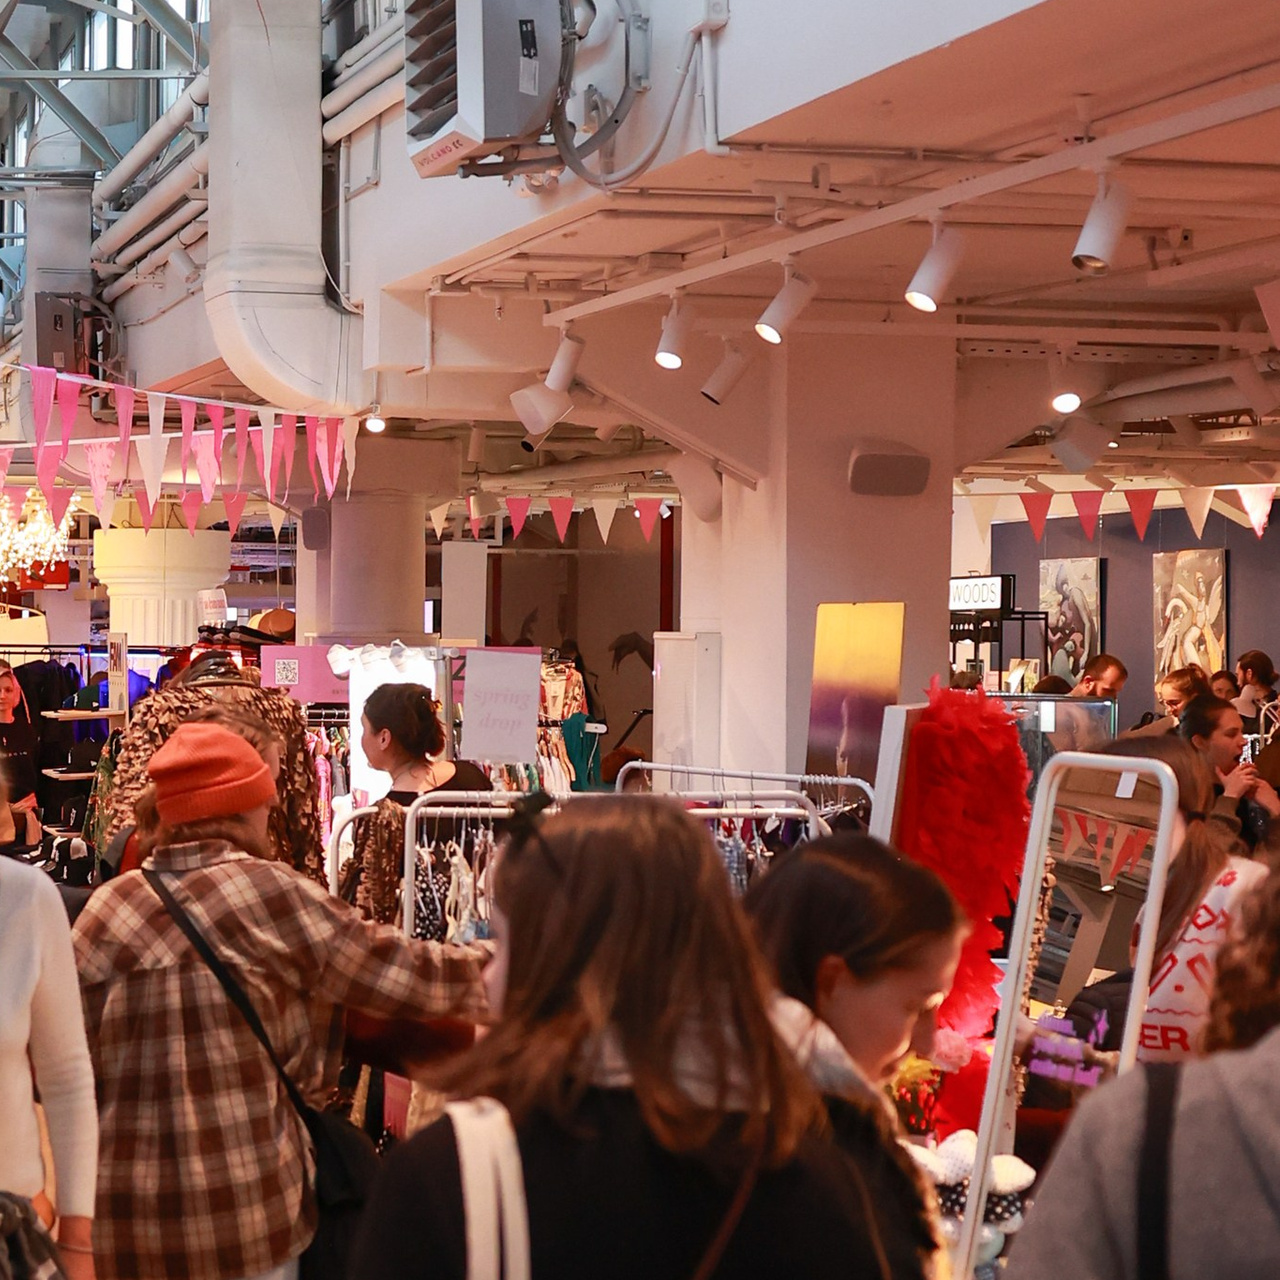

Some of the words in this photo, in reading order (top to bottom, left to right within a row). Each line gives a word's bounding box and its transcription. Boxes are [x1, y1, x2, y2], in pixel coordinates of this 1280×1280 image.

[953, 583, 997, 603] WOODS
[474, 688, 531, 710] spring
[479, 713, 521, 735] drop
